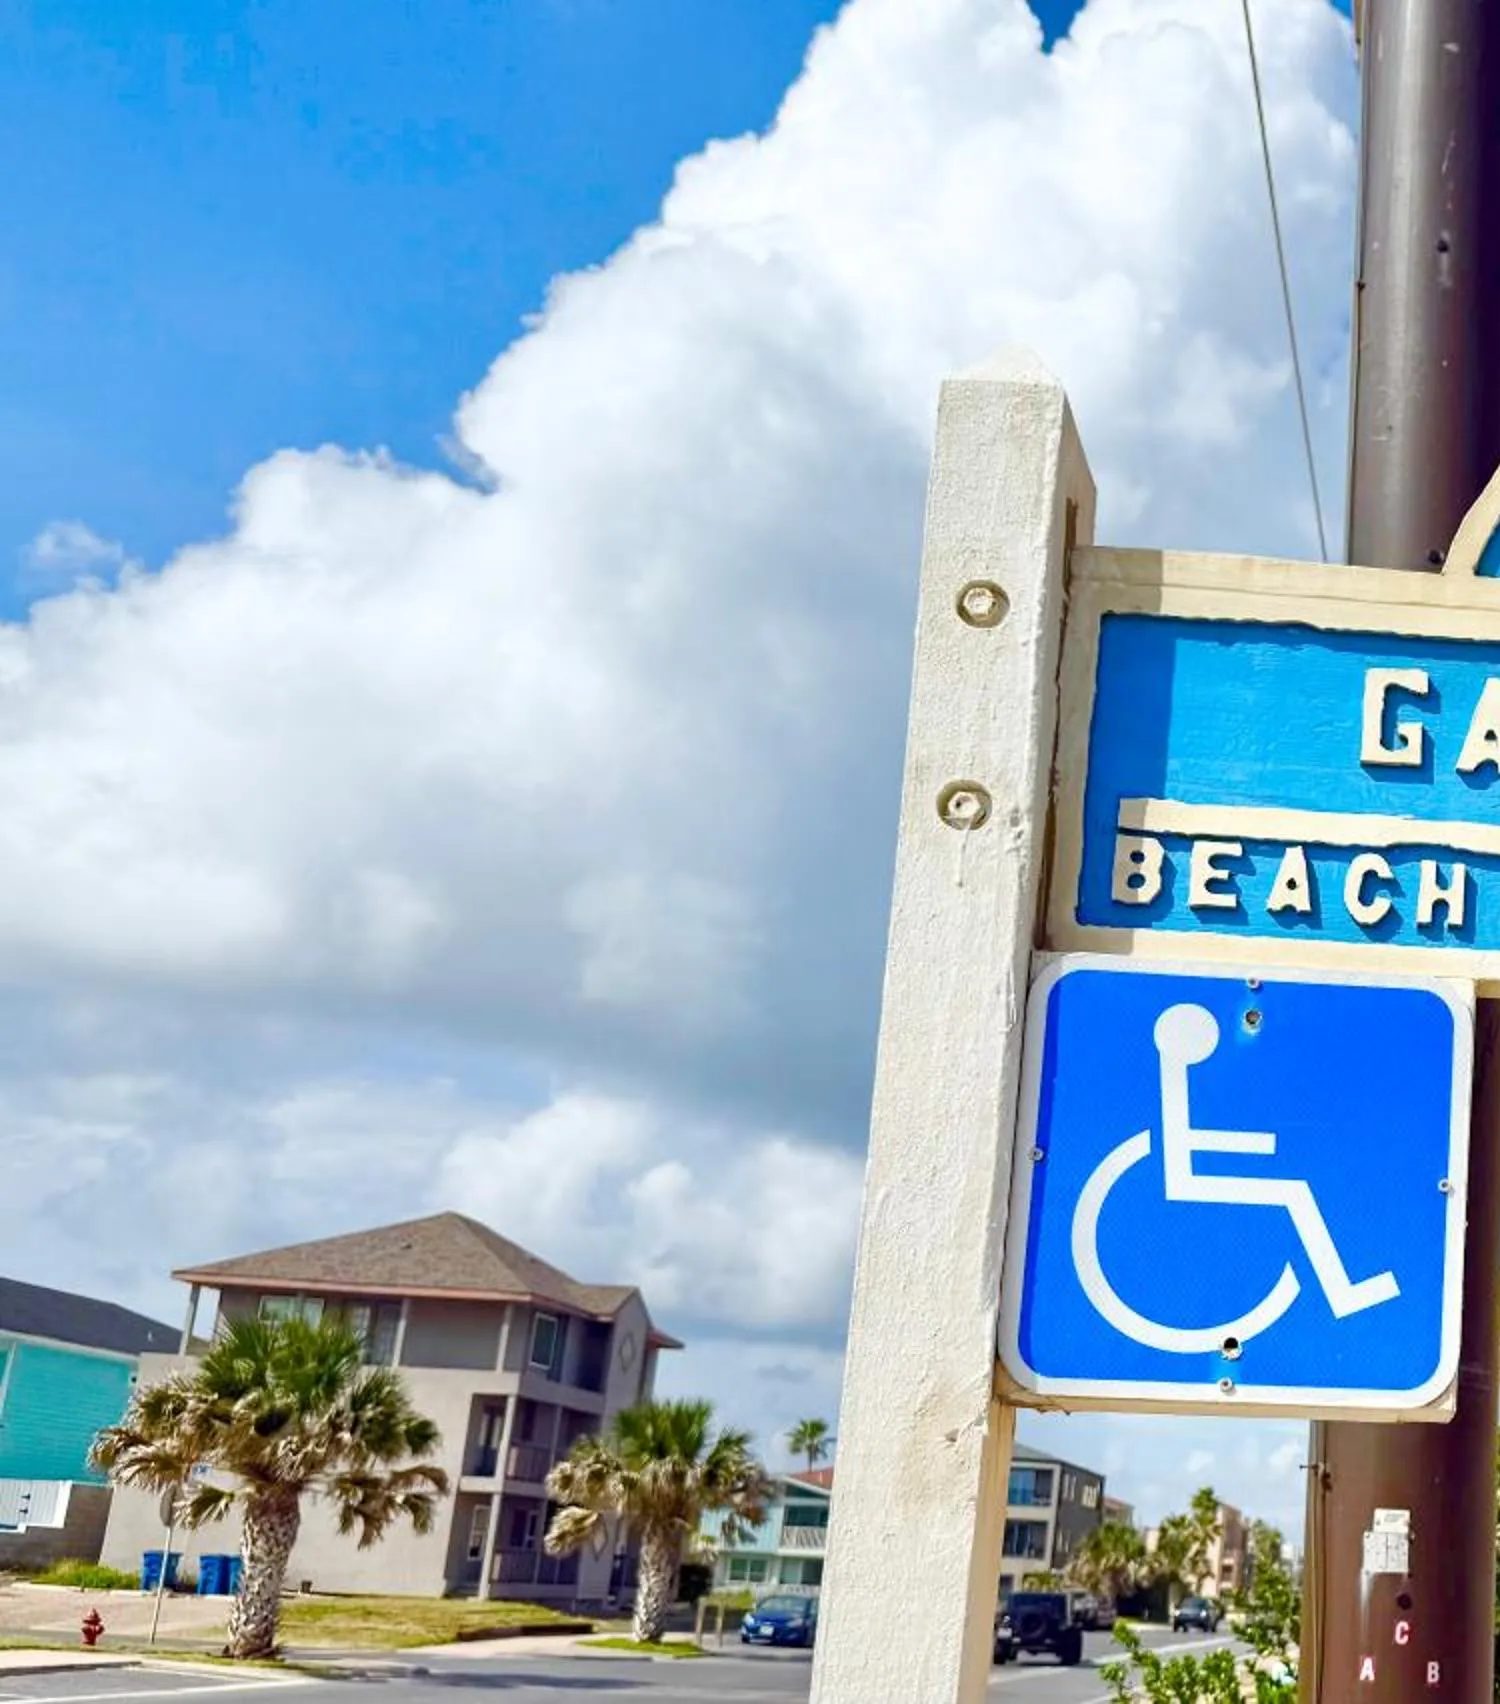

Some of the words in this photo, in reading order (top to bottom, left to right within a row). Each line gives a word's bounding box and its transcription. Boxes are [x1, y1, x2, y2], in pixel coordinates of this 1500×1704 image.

[1112, 836, 1465, 927] BEACH
[1395, 1621, 1409, 1644] C
[1359, 1657, 1375, 1681] A
[1427, 1662, 1440, 1684] B
